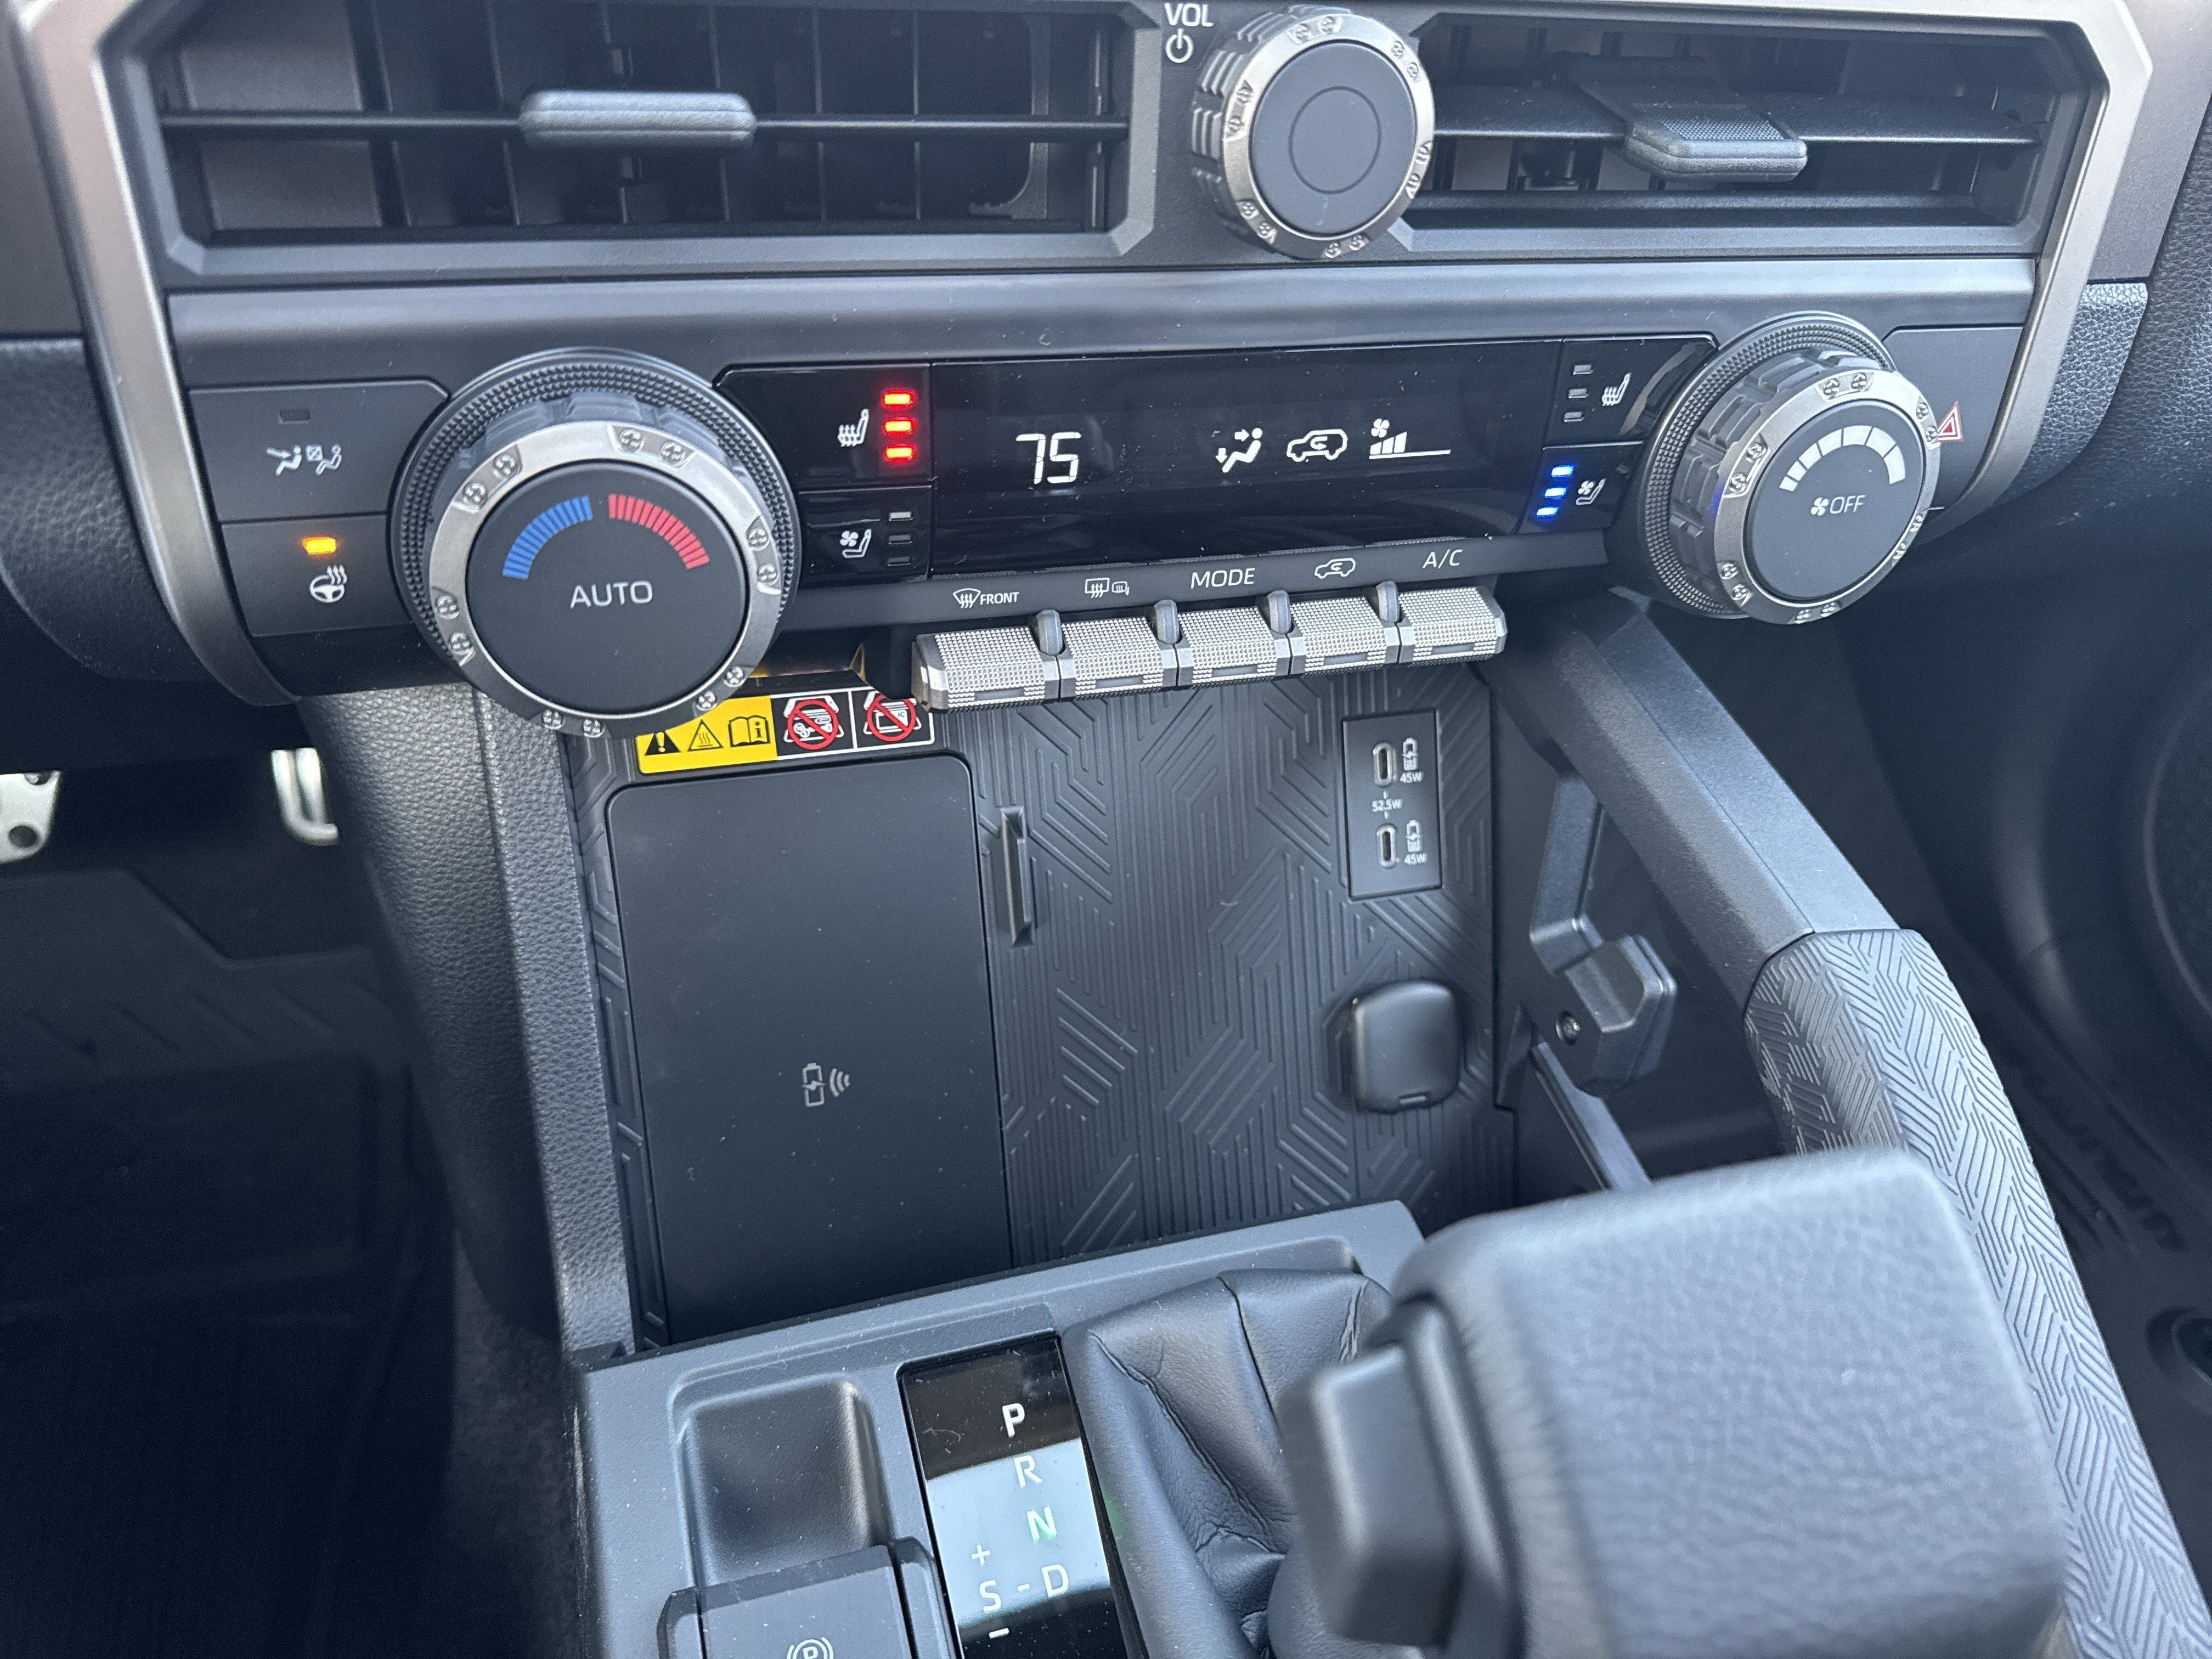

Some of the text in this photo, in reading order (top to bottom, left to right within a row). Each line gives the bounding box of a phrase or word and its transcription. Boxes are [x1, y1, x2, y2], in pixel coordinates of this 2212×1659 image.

[1164, 3, 1214, 28] VOL
[1015, 431, 1082, 485] 75
[1829, 494, 1865, 515] OFF
[1422, 549, 1463, 569] A/C
[1190, 567, 1256, 589] MODE
[570, 580, 653, 608] AUTO
[980, 590, 1019, 606] FRONT
[1400, 771, 1423, 783] 45W
[1372, 799, 1402, 812] 52.5W
[1404, 853, 1427, 865] 45W
[1002, 1403, 1025, 1437] P
[1014, 1455, 1043, 1488] R
[1026, 1506, 1057, 1543] N
[979, 1579, 1002, 1614] S
[1041, 1564, 1070, 1598] D
